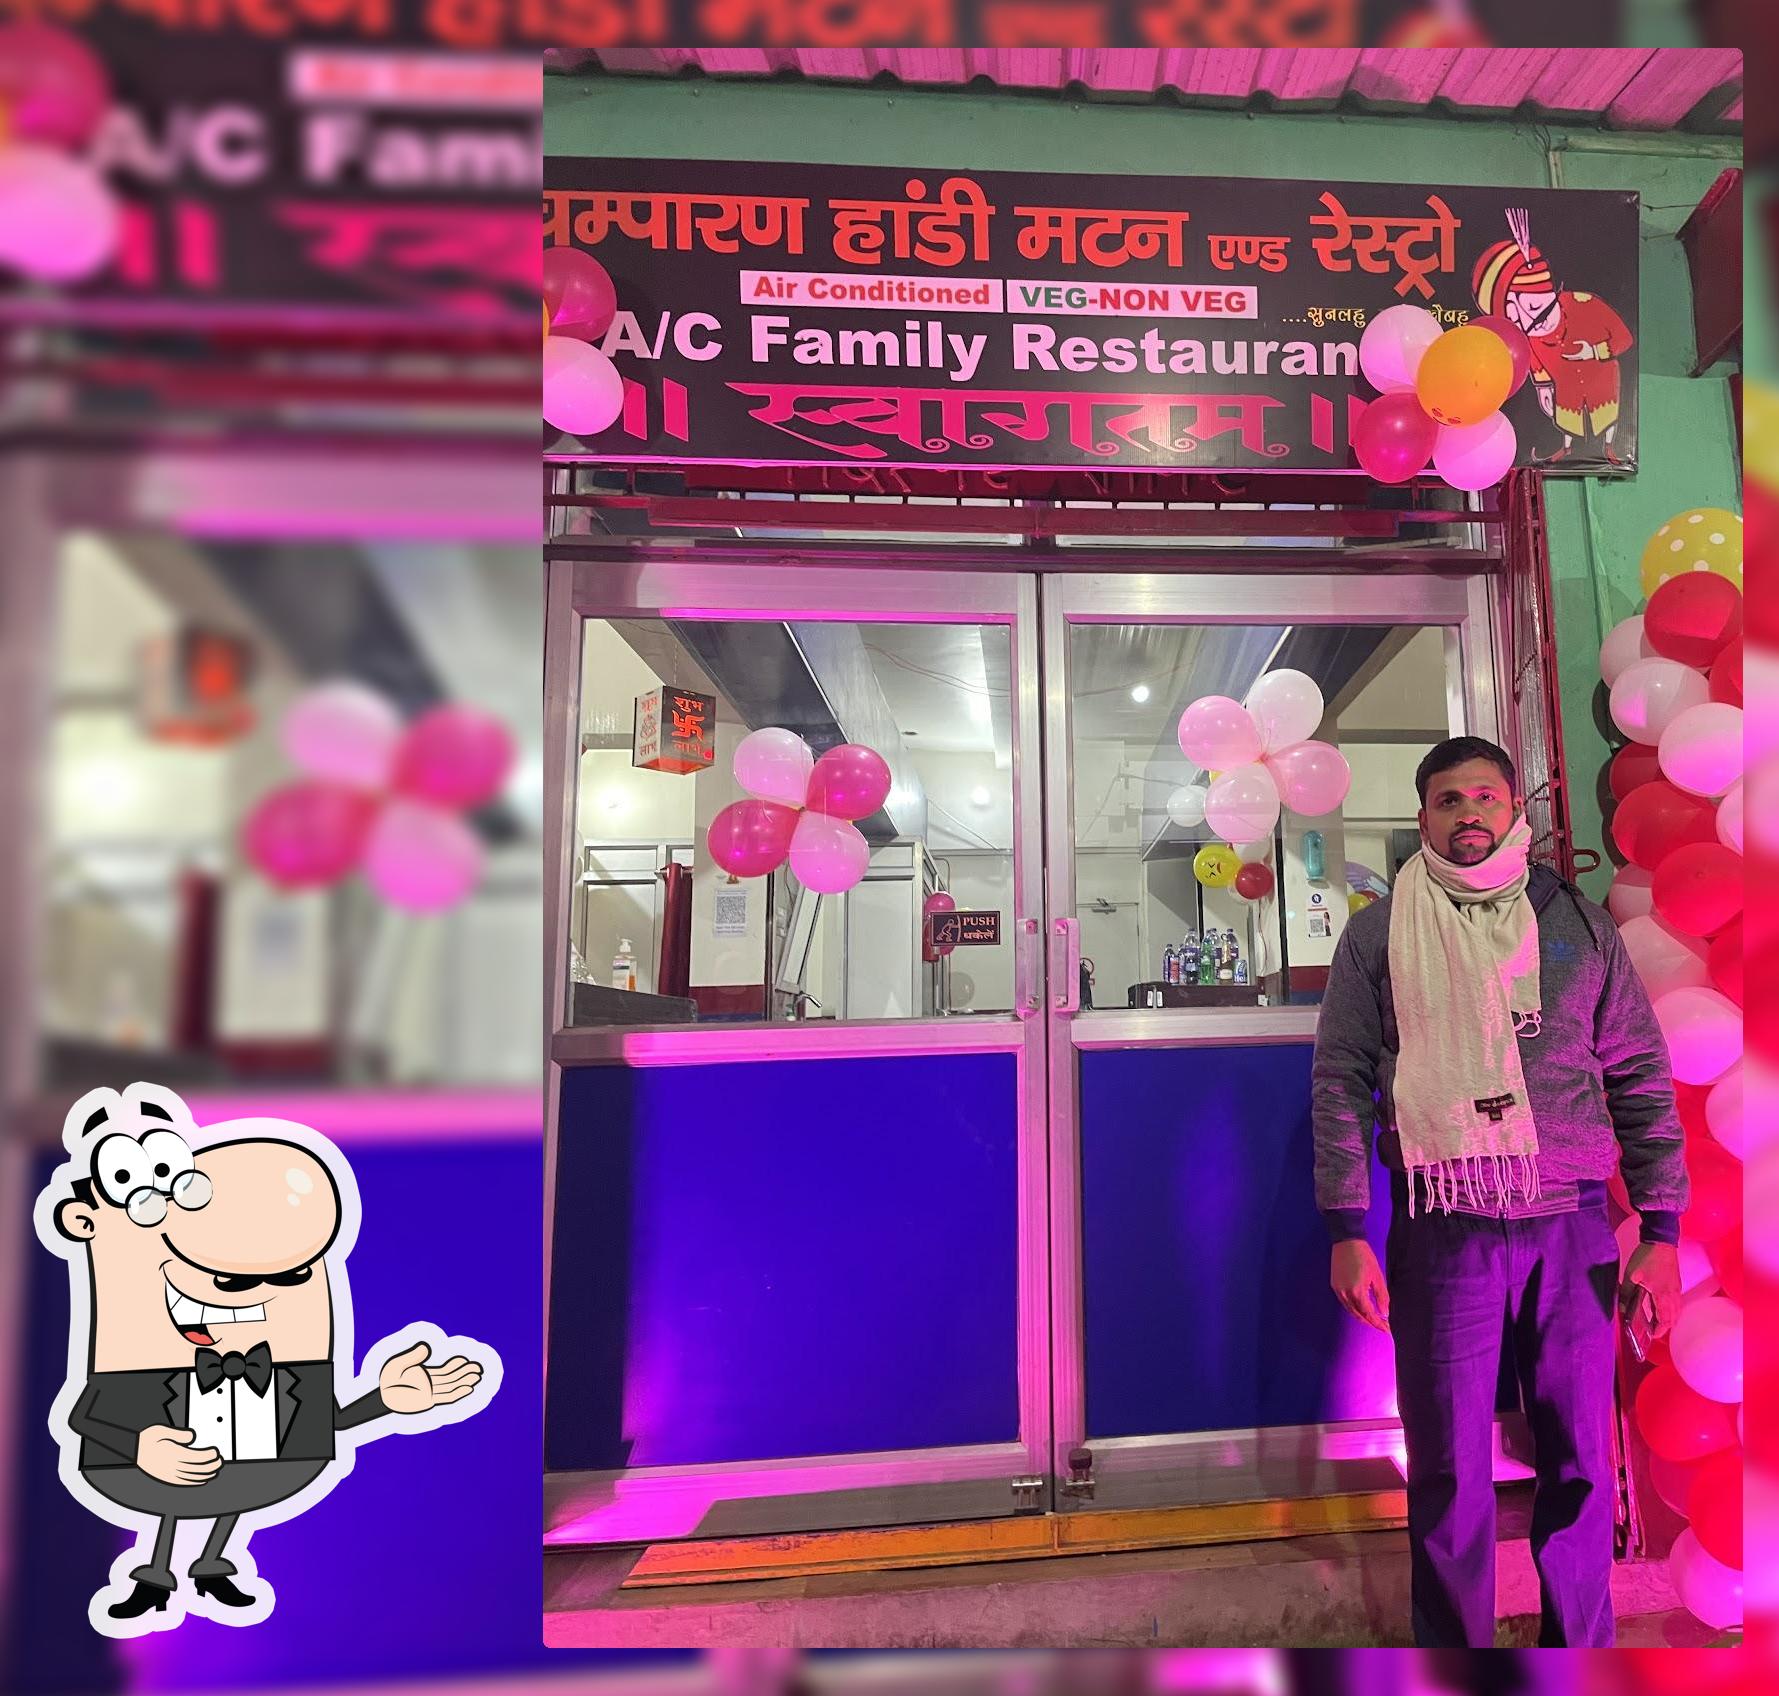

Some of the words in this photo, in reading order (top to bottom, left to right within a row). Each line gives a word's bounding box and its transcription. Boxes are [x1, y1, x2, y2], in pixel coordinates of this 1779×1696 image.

[829, 177, 996, 265] हांडी
[1014, 206, 1190, 268] मटन
[1208, 234, 1290, 273] एण्ड
[1310, 191, 1462, 299] रेस्ट्रो
[753, 276, 798, 299] Air
[808, 279, 991, 306] Conditioned
[1019, 286, 1169, 313] VEG-NON
[1181, 290, 1247, 314] VEG
[600, 311, 723, 362] A/C
[750, 315, 988, 383] Family
[1013, 324, 1360, 375] Restauran
[724, 382, 1290, 460] स्वागतम
[963, 917, 995, 926] PUSH
